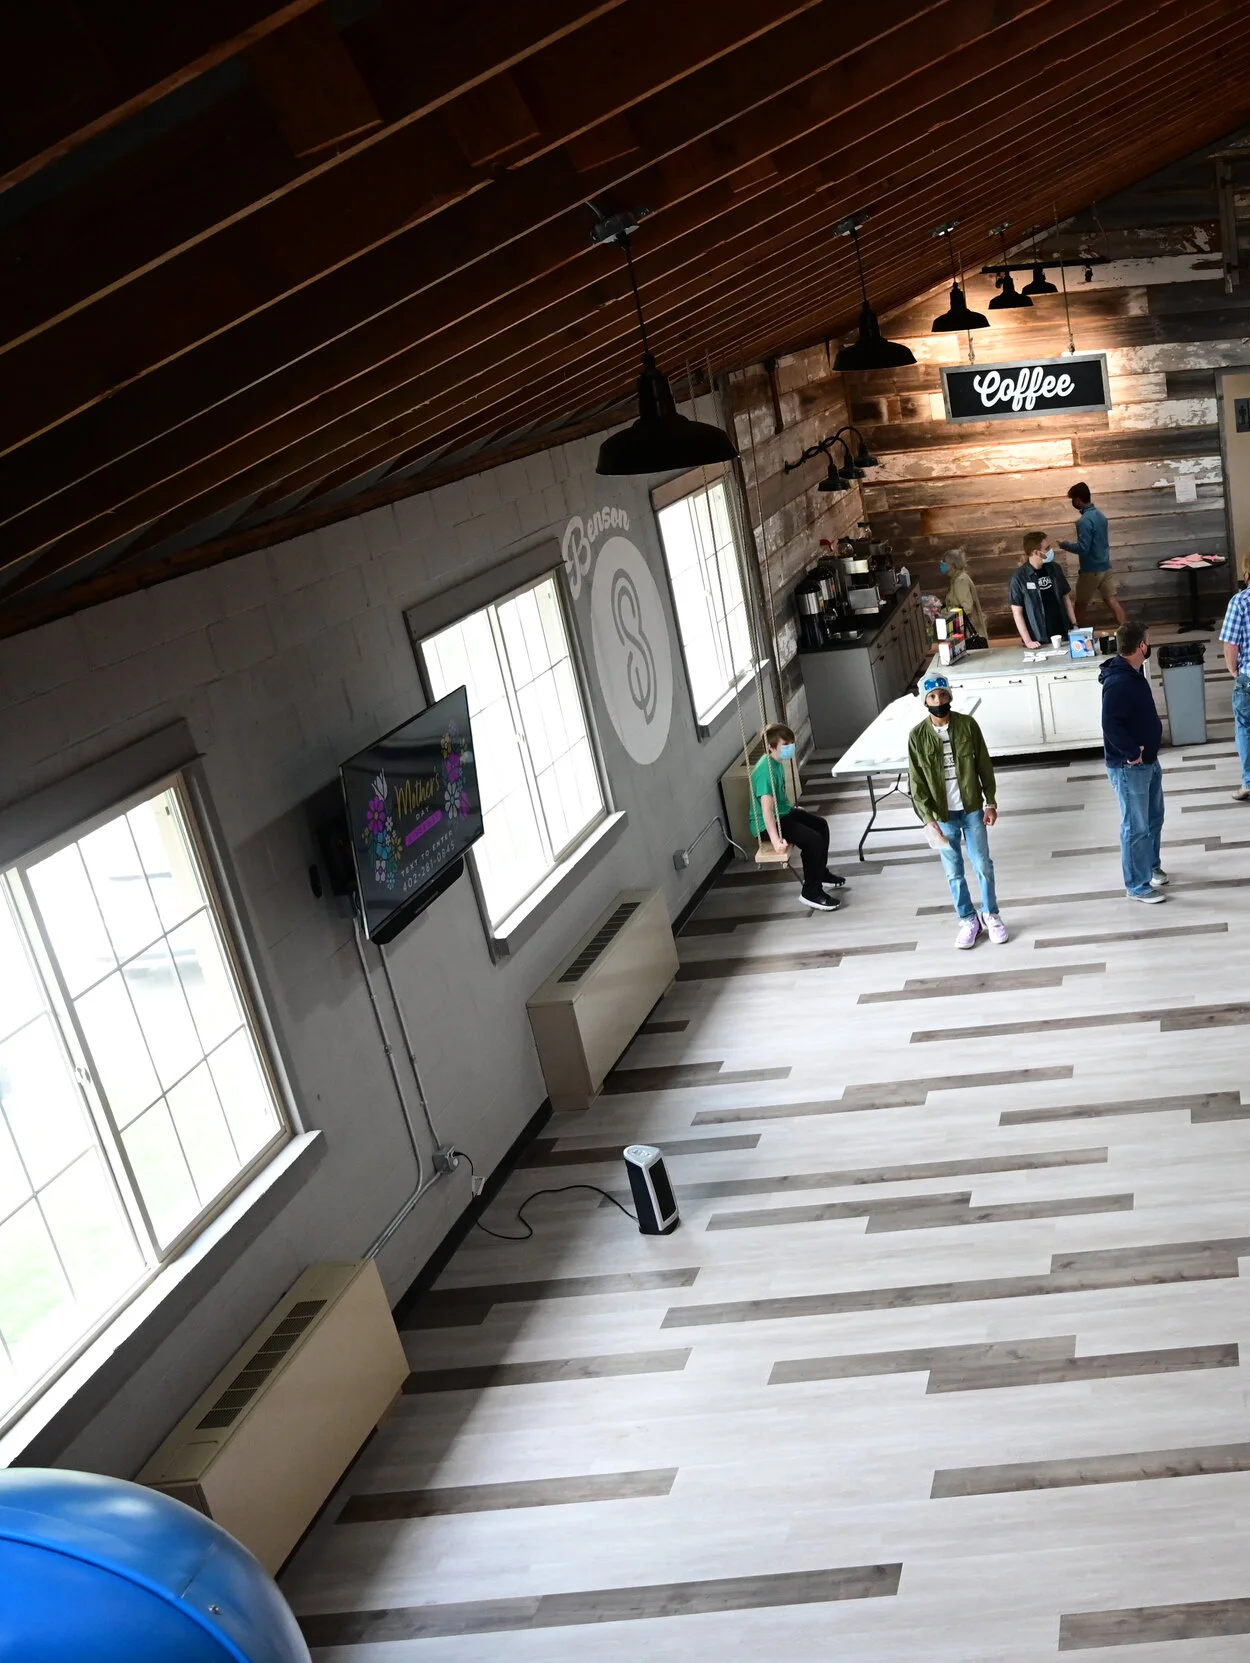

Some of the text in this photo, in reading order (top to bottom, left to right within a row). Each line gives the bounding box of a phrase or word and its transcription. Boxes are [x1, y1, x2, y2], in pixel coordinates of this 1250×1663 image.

[973, 366, 1075, 412] Coffee
[561, 505, 630, 601] Benson
[393, 765, 440, 821] Mother's
[415, 806, 430, 820] DAY
[401, 830, 453, 877] TEXT TO ENTER
